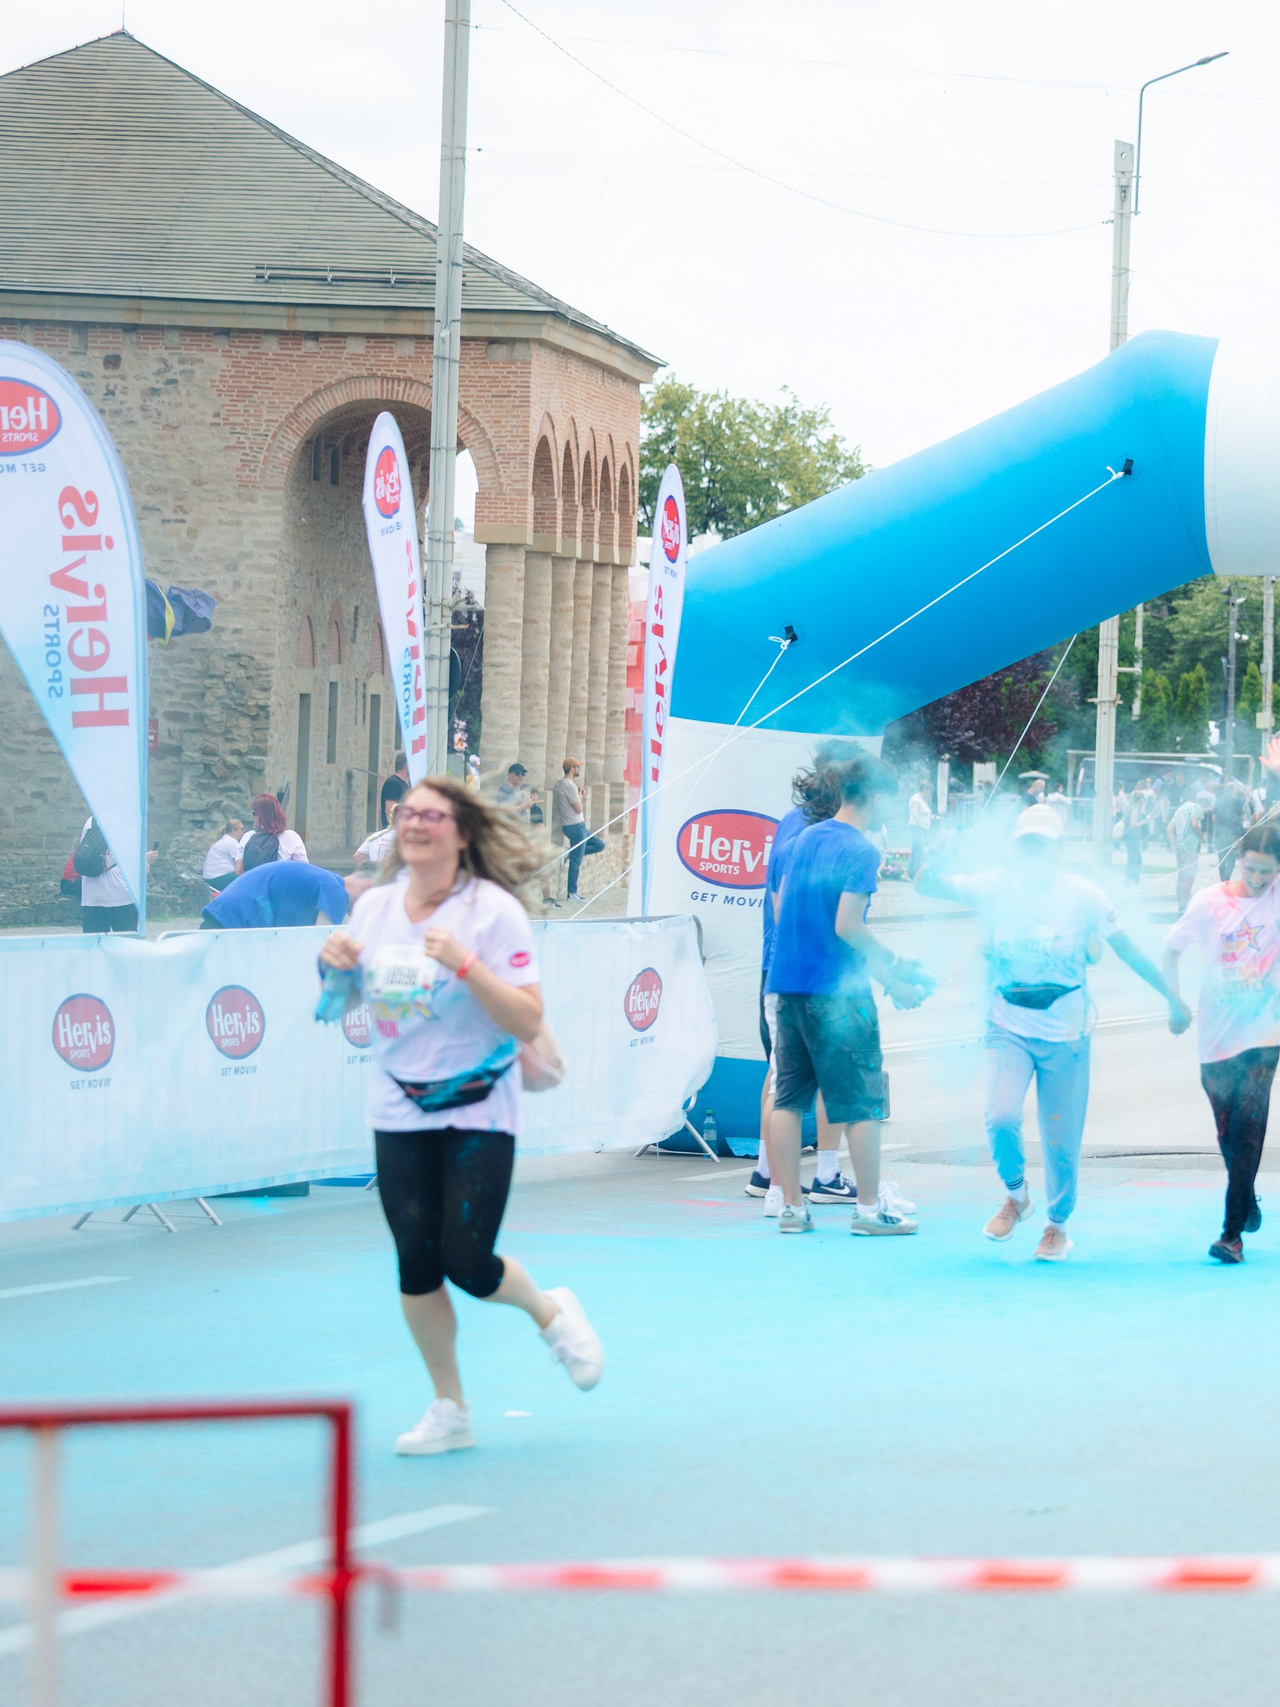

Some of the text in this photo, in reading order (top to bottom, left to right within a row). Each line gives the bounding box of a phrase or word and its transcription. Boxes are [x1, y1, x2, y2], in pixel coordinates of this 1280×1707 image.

[688, 823, 773, 873] Hervi
[699, 861, 740, 875] SPORTS
[690, 891, 763, 908] GET MOVI
[212, 1004, 260, 1042] Hervis
[58, 1014, 111, 1053] Hervis
[221, 1037, 239, 1047] SPORTS
[69, 1049, 90, 1059] SPORTS
[221, 1067, 232, 1076] GET
[70, 1080, 85, 1090] GET
